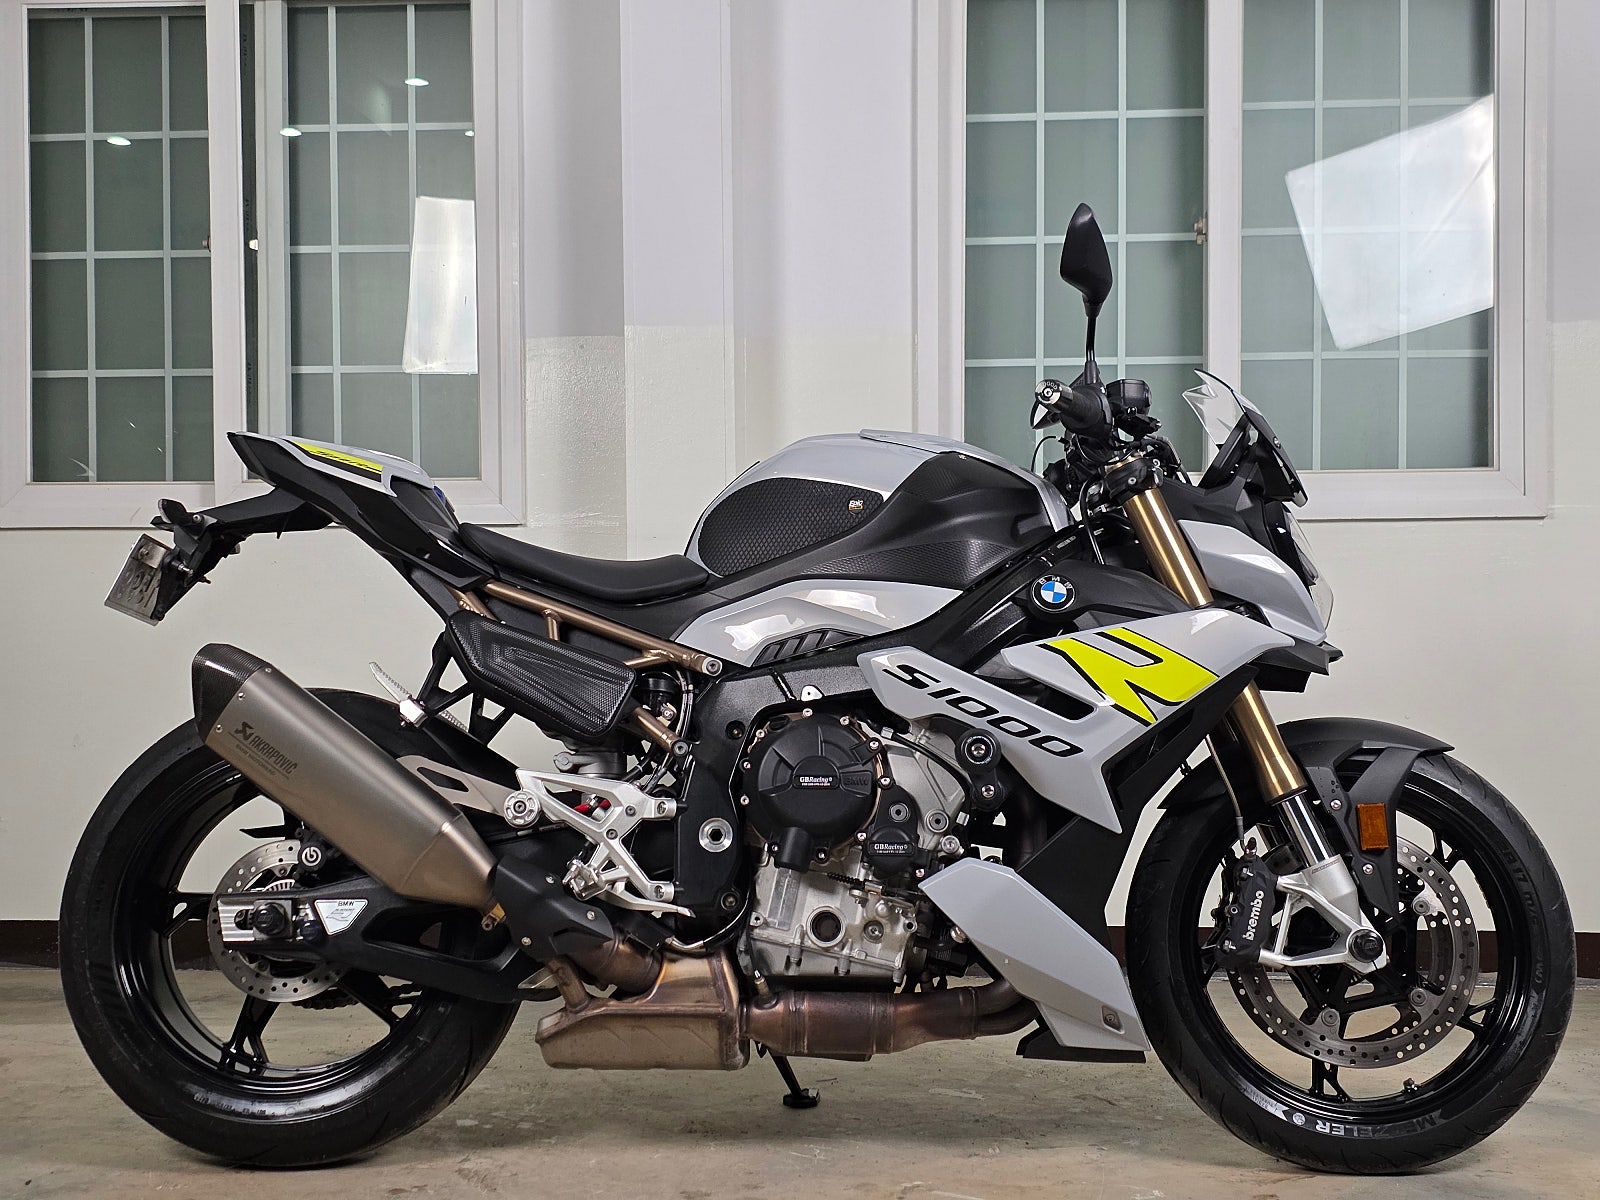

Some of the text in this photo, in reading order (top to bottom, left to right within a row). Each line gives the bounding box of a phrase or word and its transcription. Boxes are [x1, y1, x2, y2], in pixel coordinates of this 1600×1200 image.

[882, 664, 1085, 758] S1000
[1036, 626, 1220, 727] R
[1242, 890, 1265, 940] brembo
